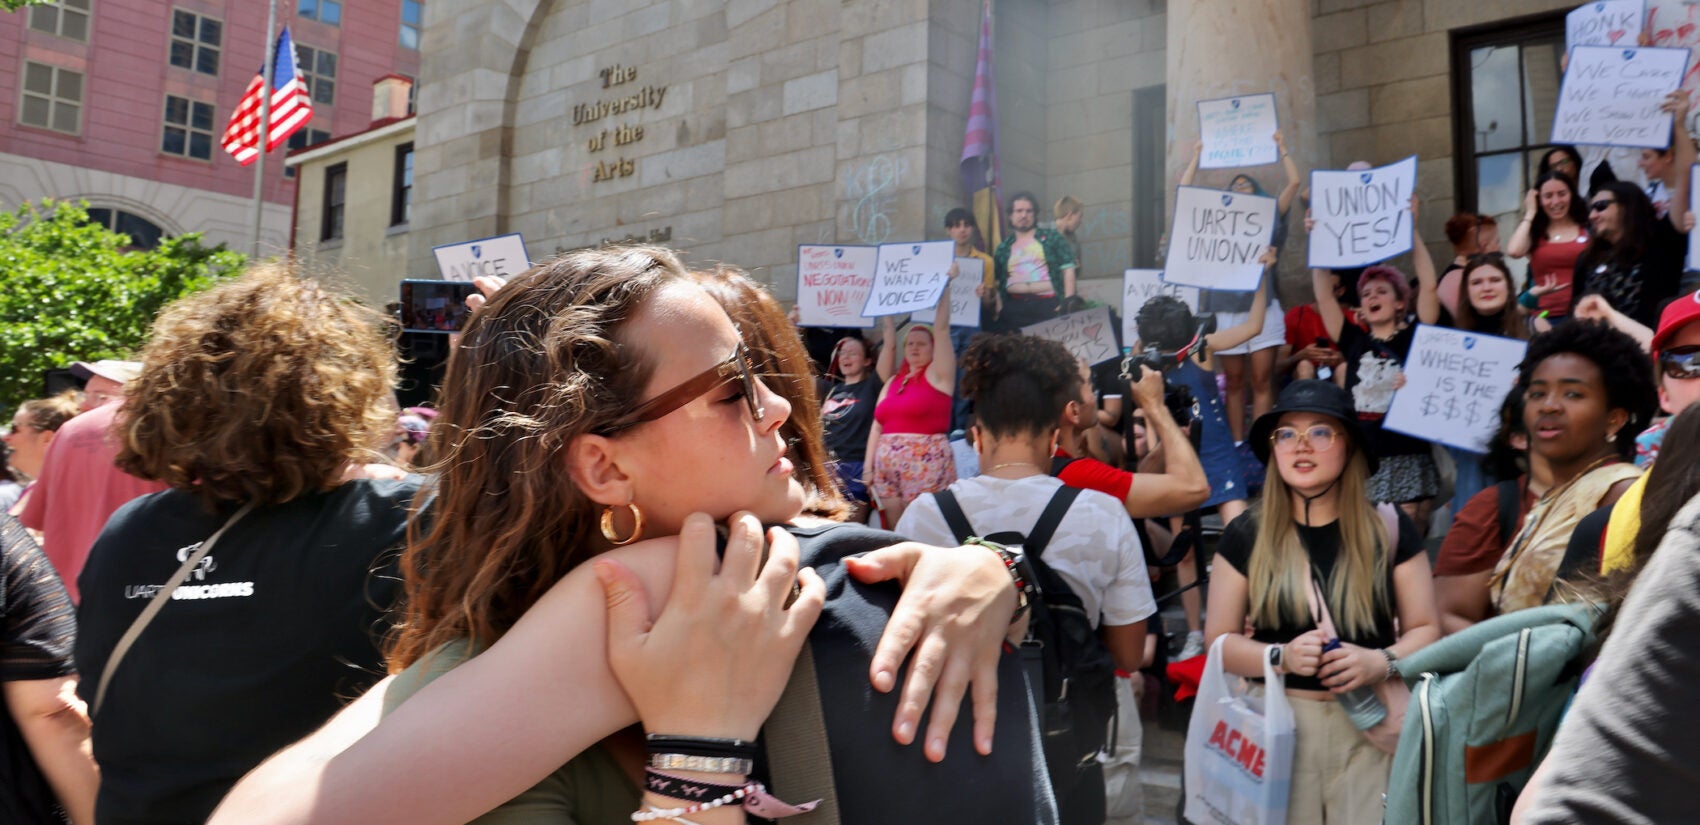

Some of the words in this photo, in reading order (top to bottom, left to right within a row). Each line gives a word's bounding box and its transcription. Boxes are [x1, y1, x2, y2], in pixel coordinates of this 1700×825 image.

[1572, 11, 1636, 41] HONK
[599, 63, 637, 89] The
[573, 85, 669, 126] University
[587, 127, 607, 153] of
[613, 121, 645, 147] the
[592, 156, 635, 184] Arts
[1324, 177, 1400, 217] UNION
[1192, 206, 1263, 237] UARTS
[1323, 209, 1404, 257] YES!
[1186, 236, 1261, 265] UNION!
[883, 273, 924, 287] WANT
[928, 272, 940, 284] A
[884, 258, 912, 274] WE
[878, 288, 938, 306] VOICE!
[1127, 283, 1139, 297] A
[1420, 349, 1499, 378] WHERE
[1436, 376, 1455, 393] IS
[1462, 380, 1498, 400] THE
[124, 584, 170, 599] UART
[1208, 719, 1266, 778] ACME
